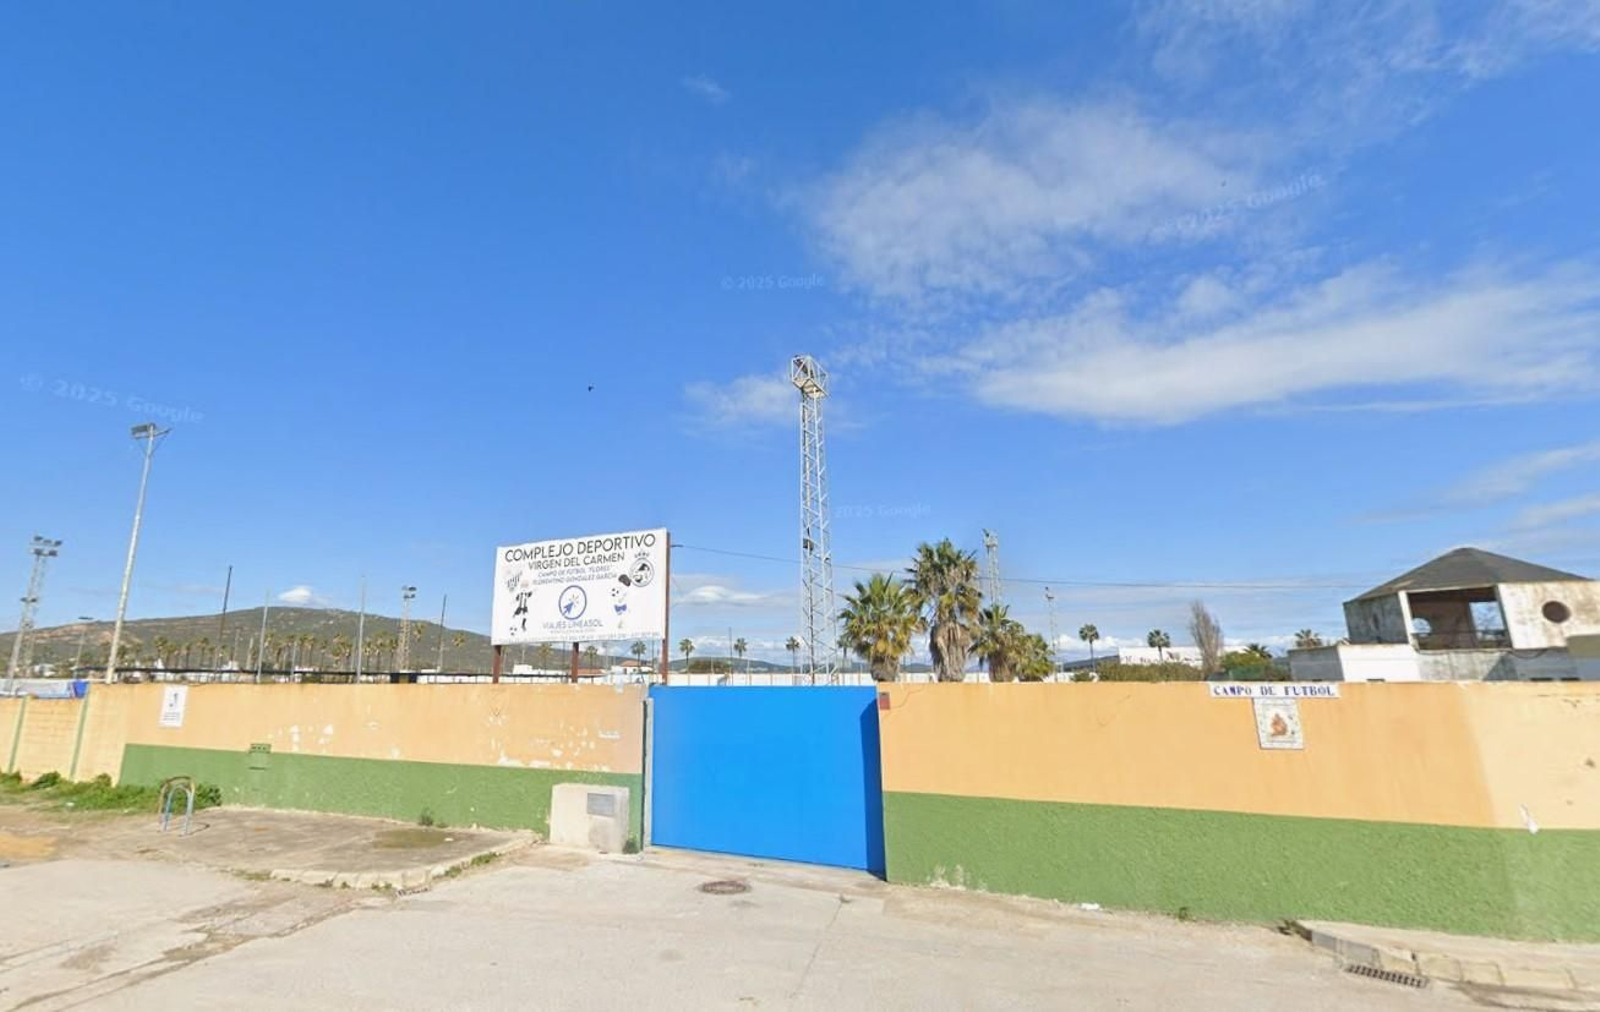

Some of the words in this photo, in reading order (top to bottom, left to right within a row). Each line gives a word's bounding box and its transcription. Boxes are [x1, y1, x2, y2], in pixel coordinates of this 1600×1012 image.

[505, 542, 574, 563] COMPLEJO
[577, 532, 656, 555] DEPORTIVO
[528, 559, 562, 571] VIRGEN
[564, 556, 581, 568] DEL
[583, 551, 625, 566] CARMEN
[542, 620, 567, 630] VIAJES
[1213, 685, 1252, 696] CAMPO
[1260, 685, 1277, 696] DE
[1284, 685, 1335, 697] FUTBOL
